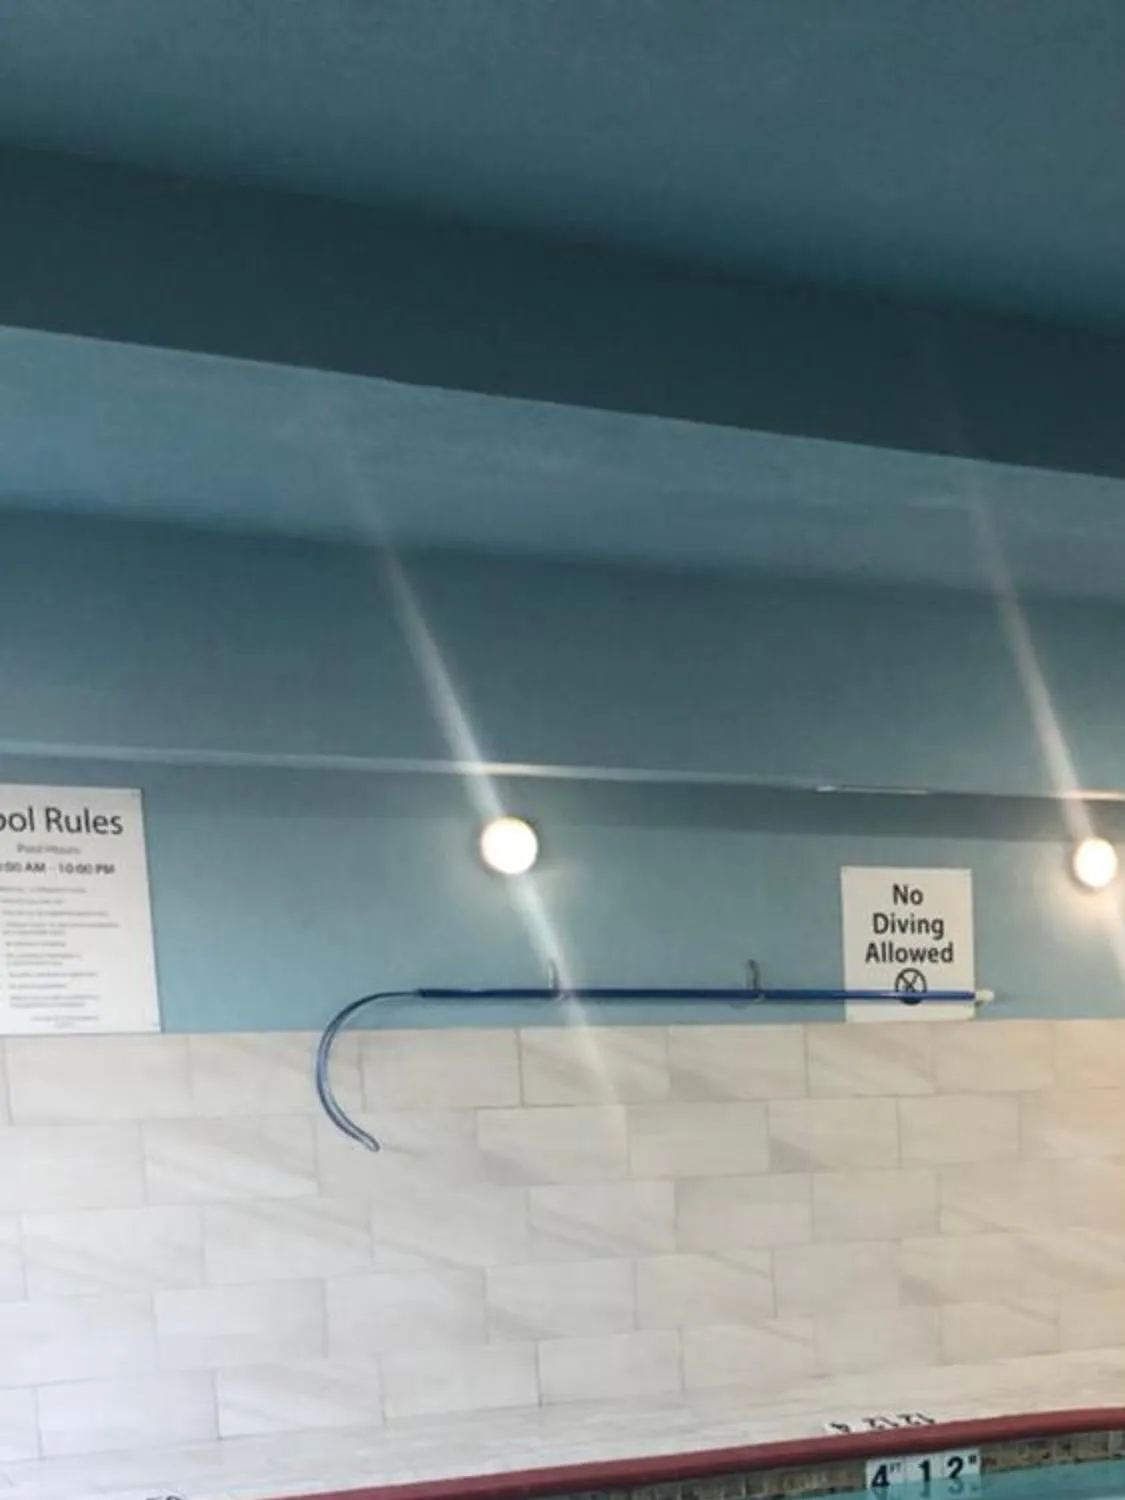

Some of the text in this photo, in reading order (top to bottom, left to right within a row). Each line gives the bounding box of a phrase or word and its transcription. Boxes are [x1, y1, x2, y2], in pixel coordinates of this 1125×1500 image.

[45, 806, 123, 835] Rules
[893, 883, 923, 905] No
[872, 912, 944, 940] Diving
[865, 941, 954, 963] Allowed
